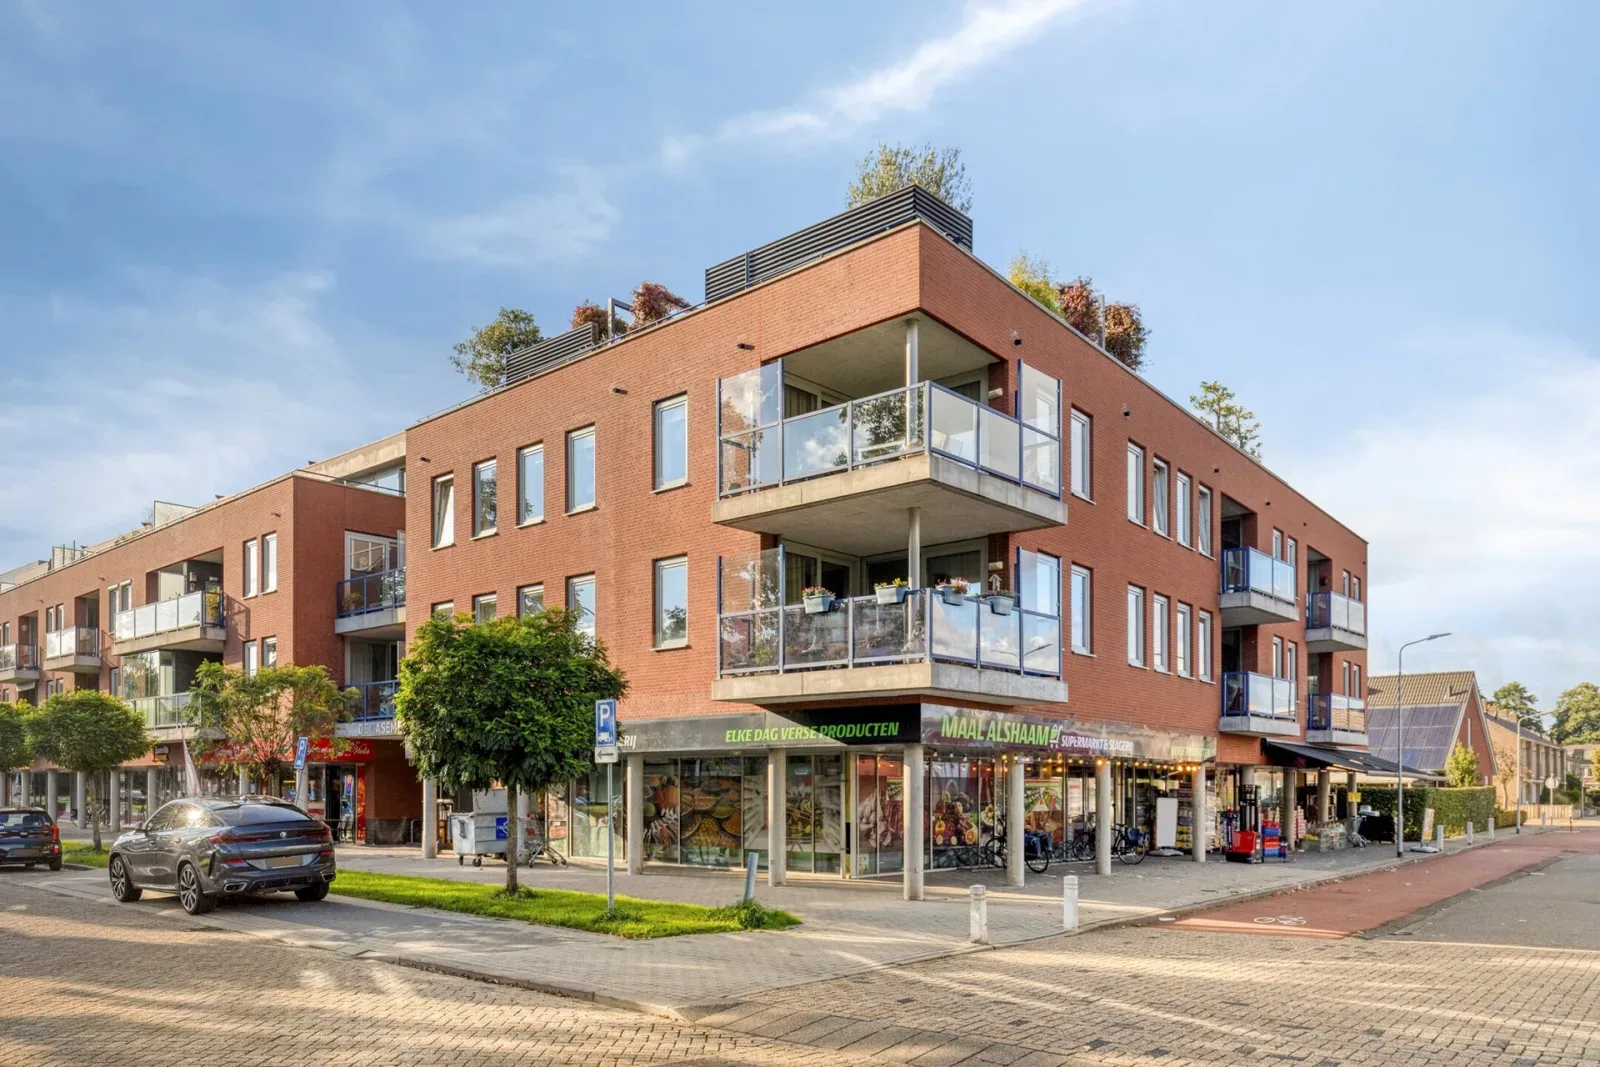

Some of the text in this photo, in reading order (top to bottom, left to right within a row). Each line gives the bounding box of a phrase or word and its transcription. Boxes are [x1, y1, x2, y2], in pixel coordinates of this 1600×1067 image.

[600, 704, 610, 727] P
[725, 722, 899, 742] ELKE DAG VERSE PRODUCTEN
[941, 714, 1049, 745] MAAL ALSHAAM
[299, 741, 305, 755] P
[1061, 735, 1103, 749] SUPERMARKT
